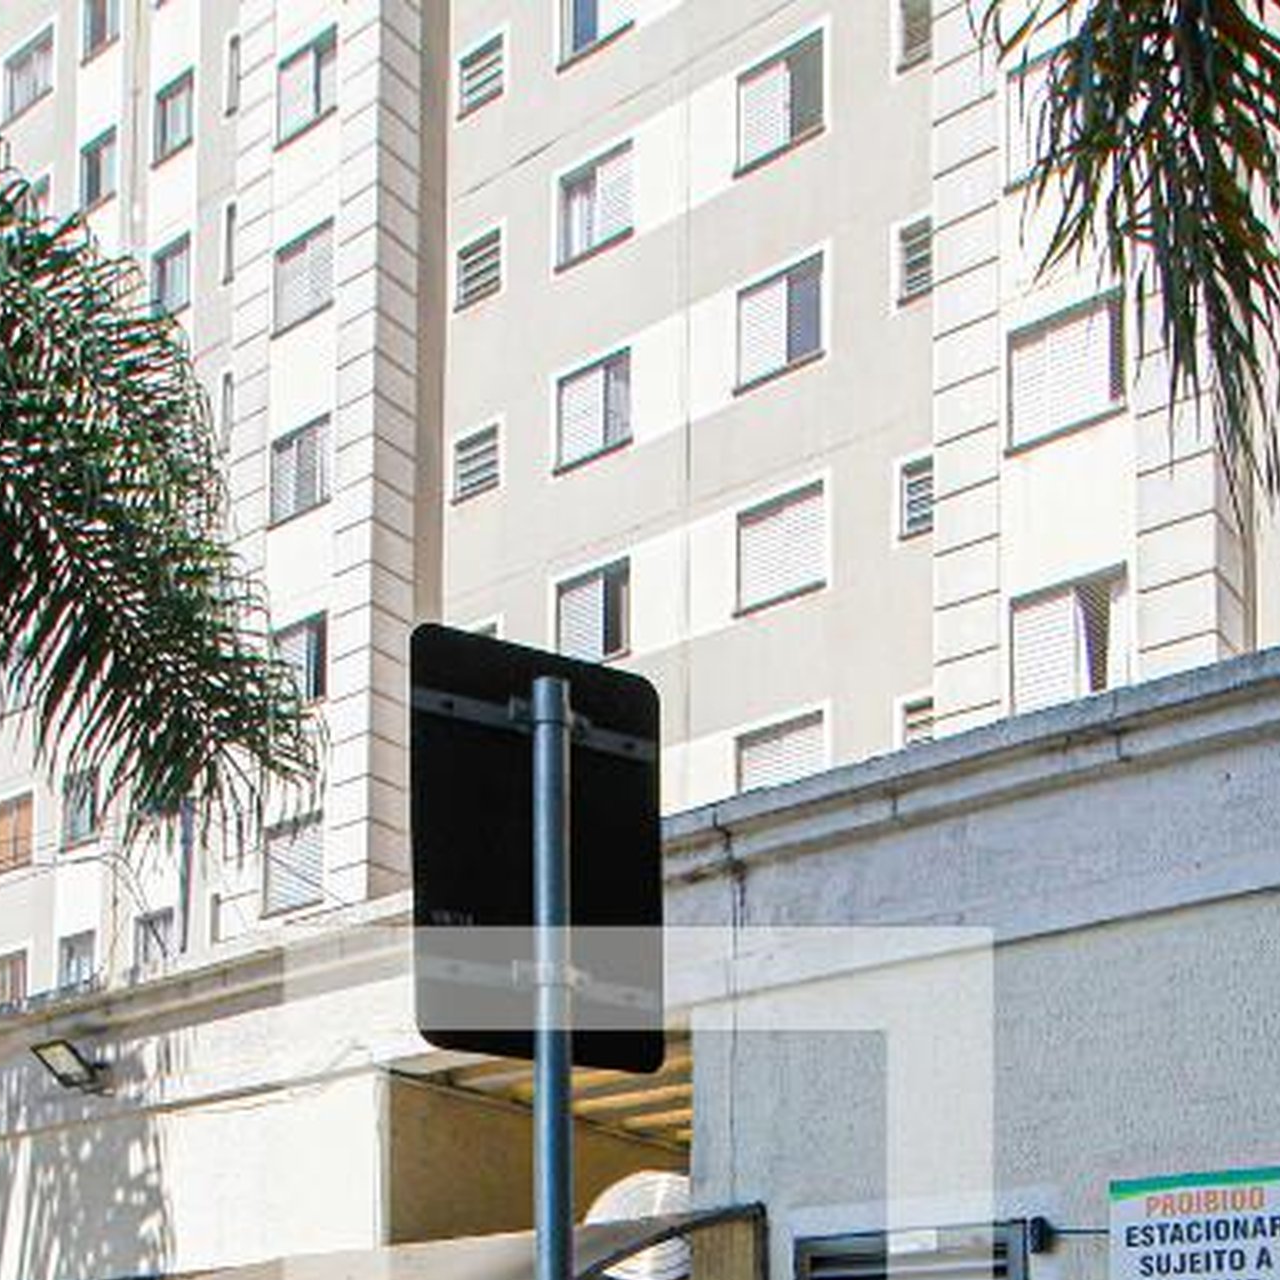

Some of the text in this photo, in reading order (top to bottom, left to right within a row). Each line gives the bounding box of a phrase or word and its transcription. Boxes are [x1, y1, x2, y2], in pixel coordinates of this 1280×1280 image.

[1146, 1187, 1264, 1217] PROIBIDO
[1139, 1247, 1273, 1277] SUJEITO A
